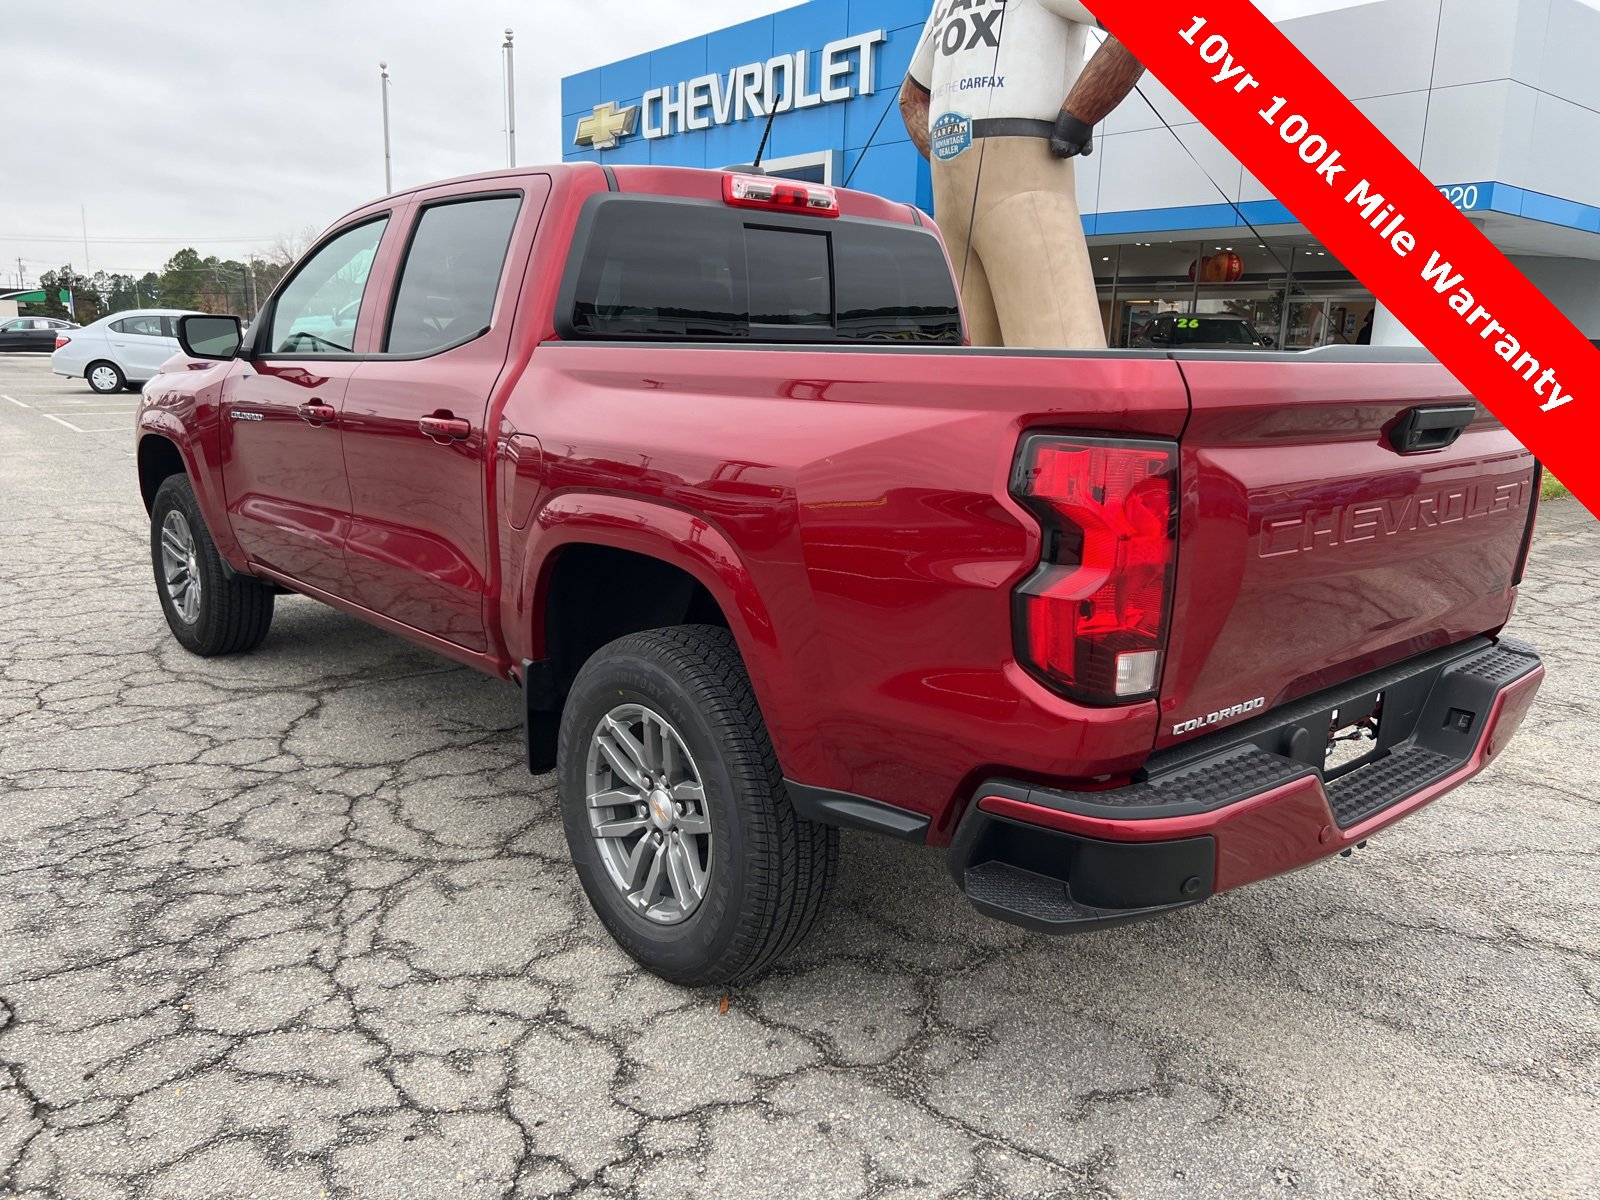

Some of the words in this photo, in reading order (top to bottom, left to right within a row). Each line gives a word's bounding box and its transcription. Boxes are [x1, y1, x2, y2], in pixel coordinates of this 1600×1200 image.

[933, 9, 1004, 57] FOX
[641, 29, 887, 140] CHEVROLET
[959, 76, 1005, 91] CARFAX
[933, 123, 967, 139] CARFAX
[935, 135, 965, 149] ADVANTAGE
[938, 144, 959, 157] DEALER
[1258, 480, 1529, 558] CHEVROLET
[1172, 696, 1266, 736] COLORADO
